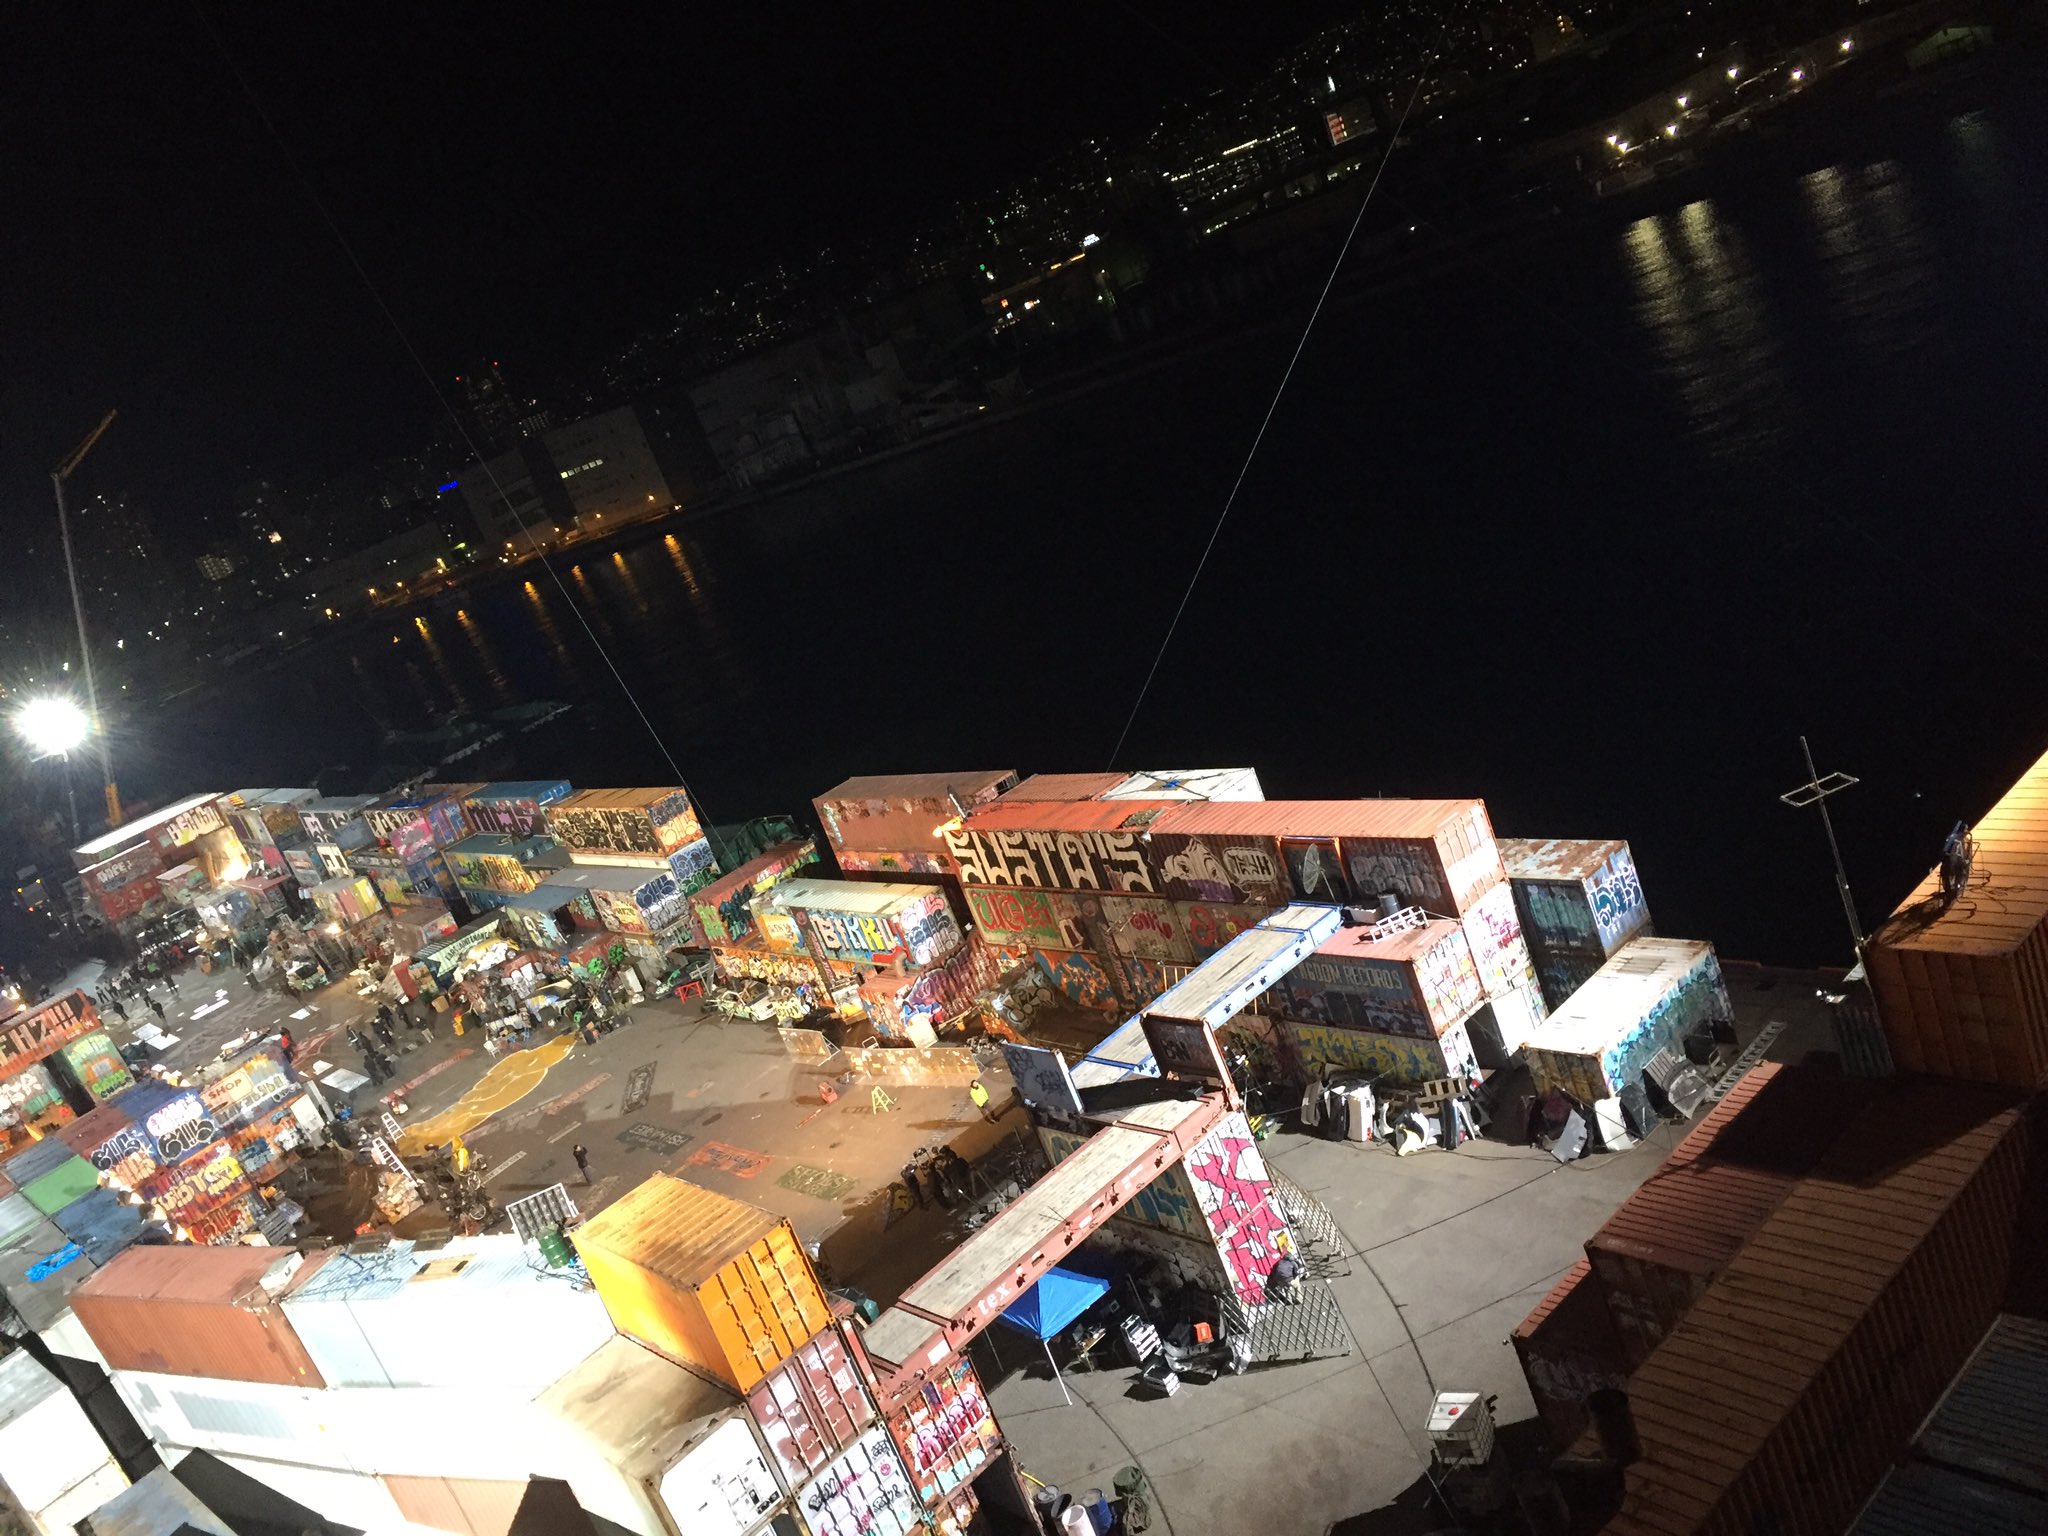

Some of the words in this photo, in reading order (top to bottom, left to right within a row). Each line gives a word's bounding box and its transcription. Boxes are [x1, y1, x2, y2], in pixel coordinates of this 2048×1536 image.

[1343, 966, 1404, 990] RECORDS
[208, 1078, 242, 1100] SHOP
[978, 1281, 1011, 1317] tex
